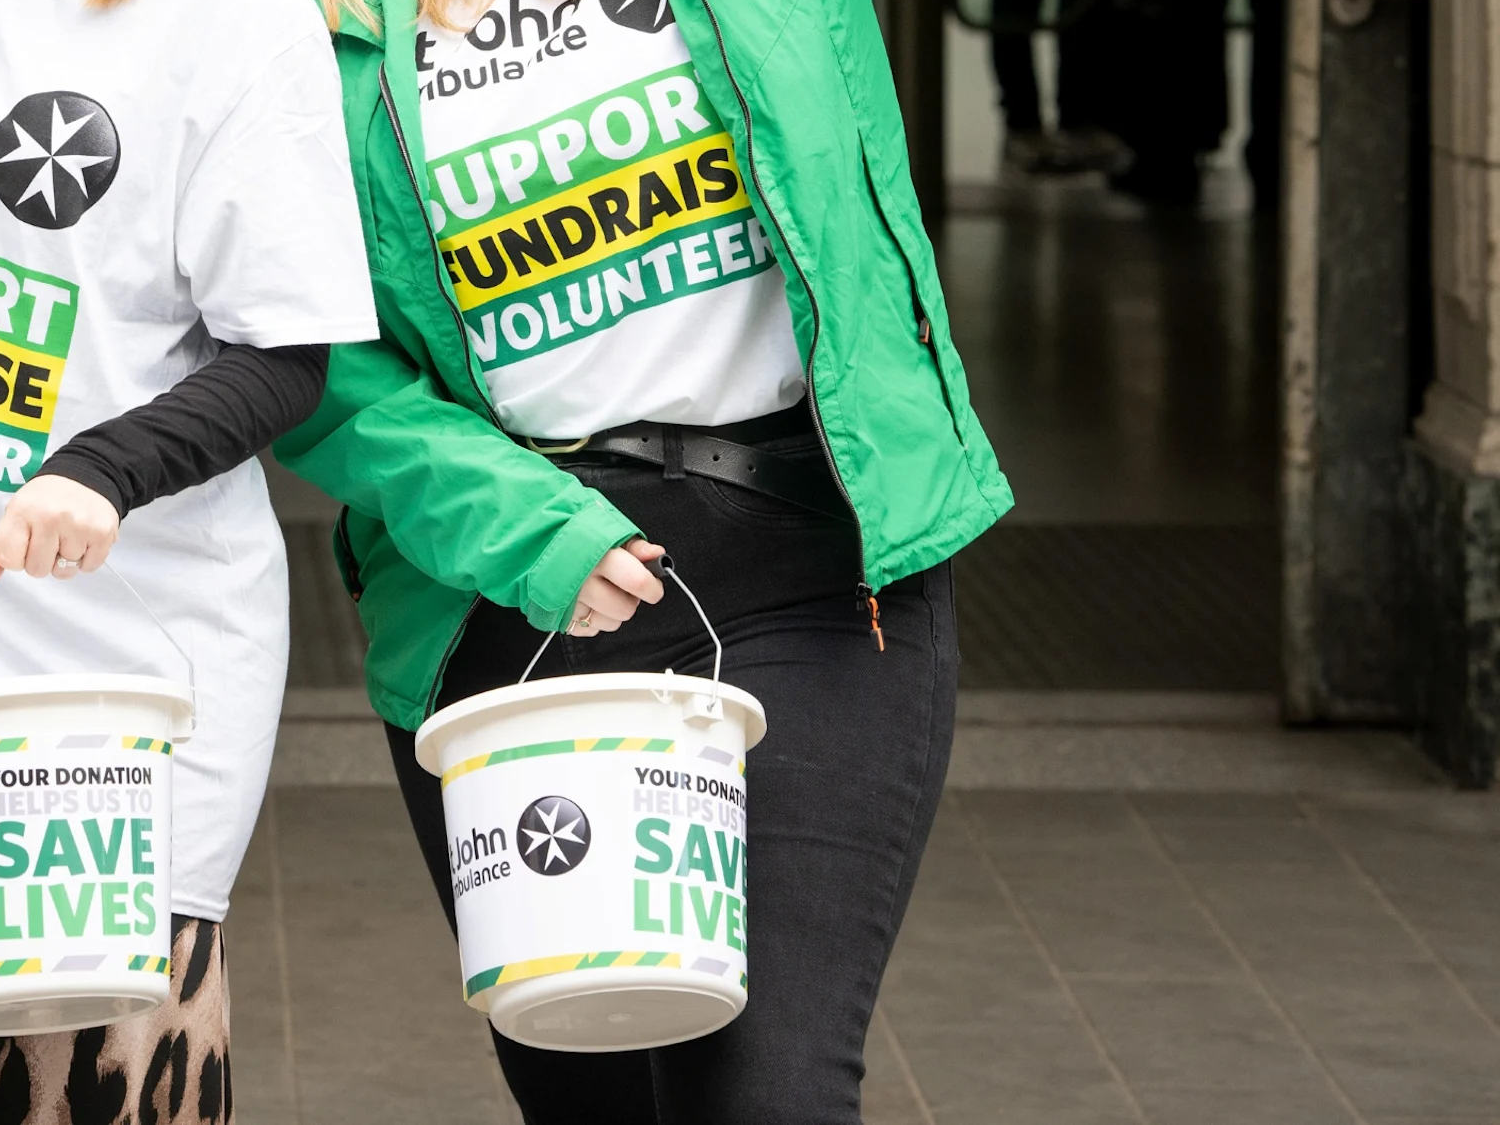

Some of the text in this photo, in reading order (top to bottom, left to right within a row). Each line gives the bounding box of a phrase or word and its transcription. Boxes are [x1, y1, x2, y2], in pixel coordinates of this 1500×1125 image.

[442, 142, 747, 289] FUNDRAIS
[55, 767, 152, 786] DONATION
[634, 767, 692, 791] YOUR
[87, 789, 120, 814] US
[125, 789, 152, 814] TO
[633, 788, 714, 823] HELPS
[718, 802, 739, 832] US
[456, 827, 507, 871] John
